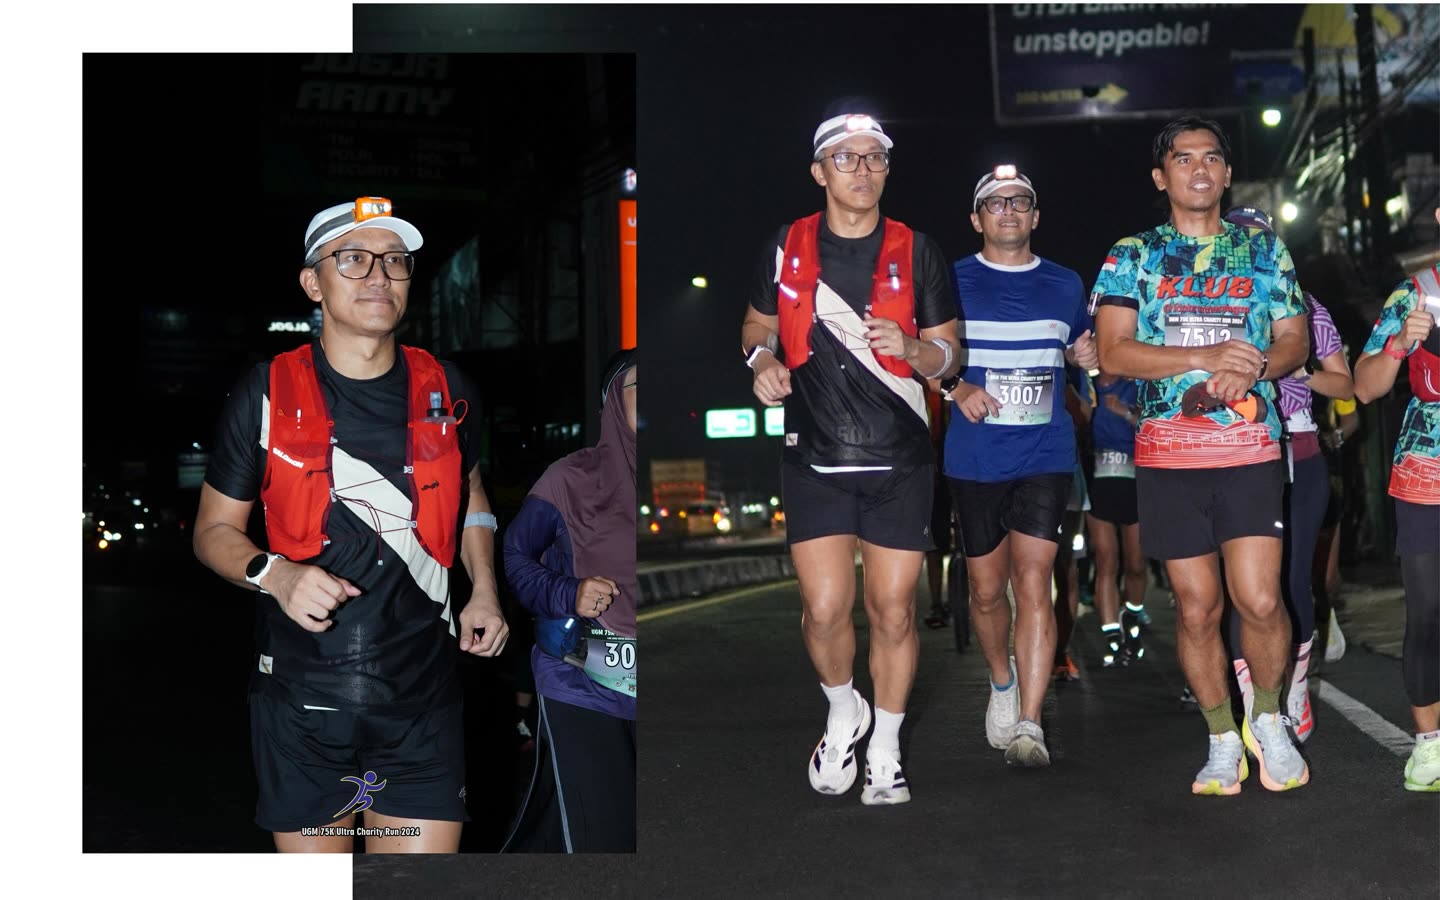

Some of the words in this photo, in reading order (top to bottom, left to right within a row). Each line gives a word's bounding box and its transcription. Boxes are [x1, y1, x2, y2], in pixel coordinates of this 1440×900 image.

[1014, 22, 1211, 57] unstoppable!
[1157, 276, 1254, 299] KLUB
[999, 385, 1044, 406] 3007
[1102, 452, 1128, 464] 7507
[605, 642, 636, 669] 30
